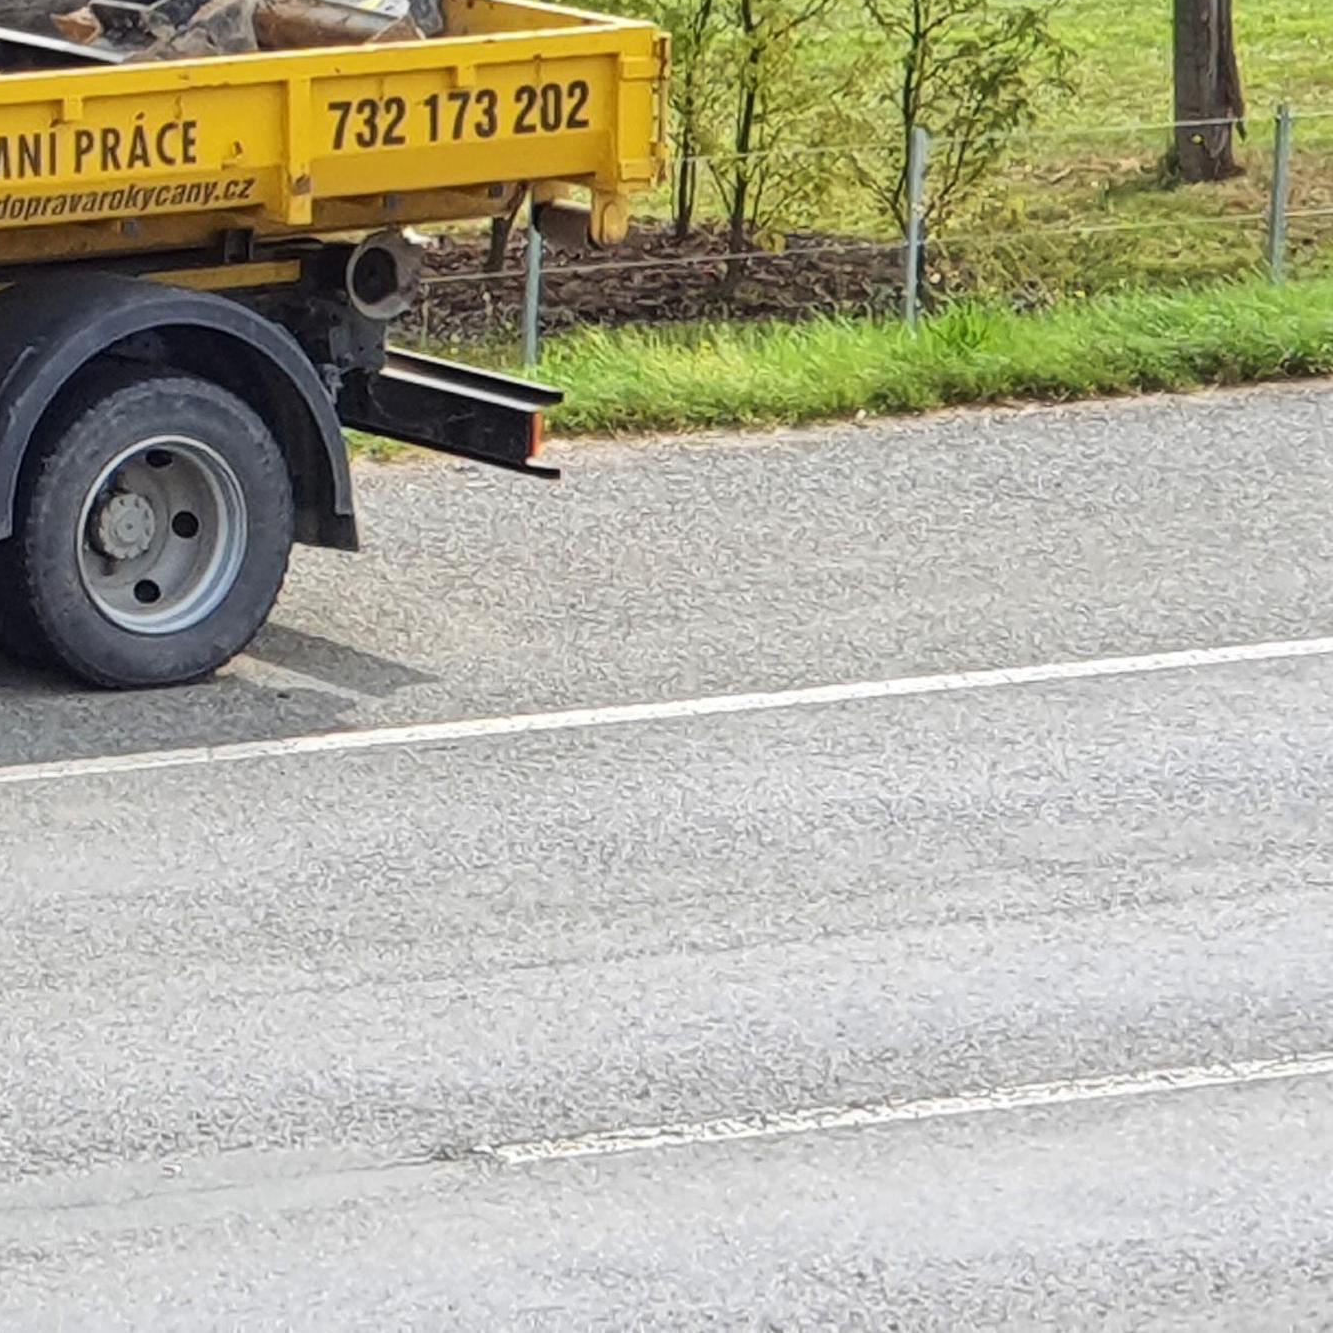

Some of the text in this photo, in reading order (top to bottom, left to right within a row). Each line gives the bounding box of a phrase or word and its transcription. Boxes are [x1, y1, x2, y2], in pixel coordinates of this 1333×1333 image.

[74, 112, 197, 174] PRÁCE
[328, 79, 589, 151] 732 173 202
